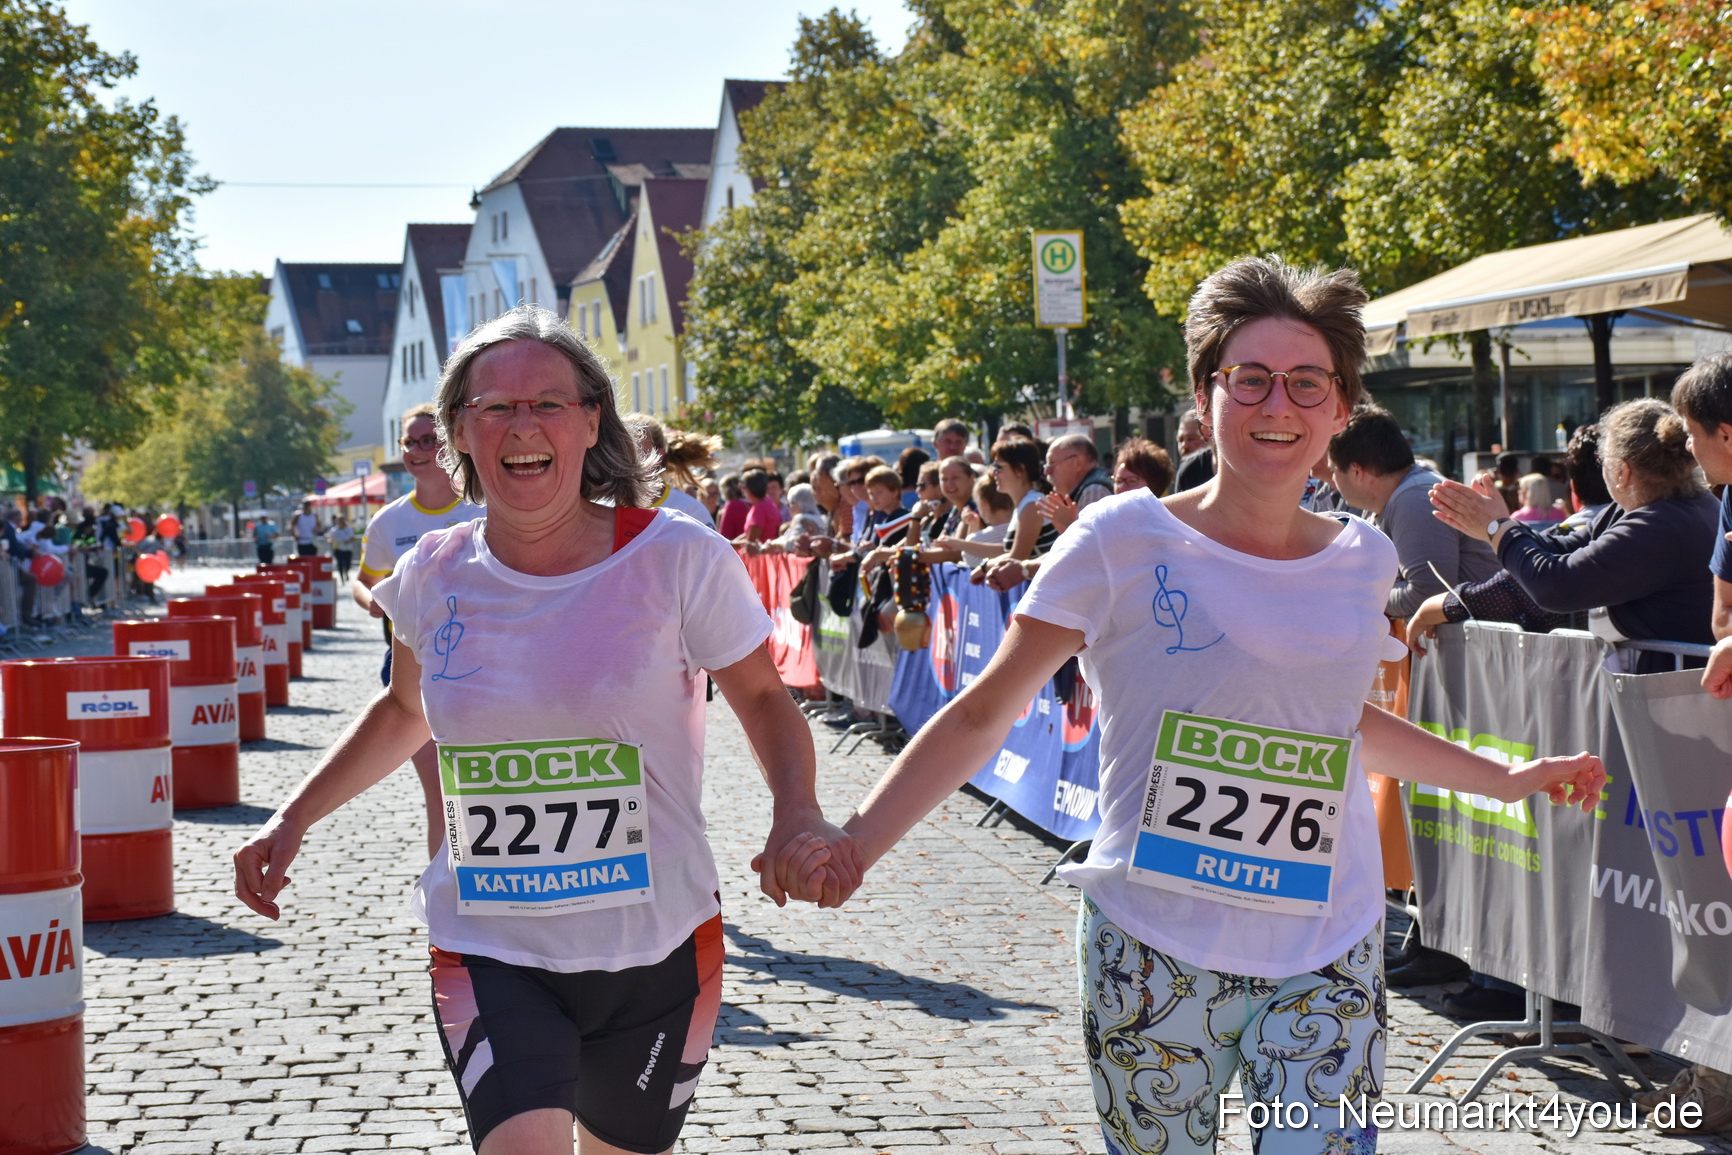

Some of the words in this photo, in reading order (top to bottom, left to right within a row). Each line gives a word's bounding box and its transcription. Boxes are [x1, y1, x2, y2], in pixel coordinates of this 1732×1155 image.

[191, 698, 236, 726] AVIA
[454, 744, 627, 789] BOCK
[1171, 719, 1339, 784] BOCK
[628, 800, 637, 811] D
[1166, 776, 1325, 852] 2276
[1328, 805, 1336, 816] D
[467, 798, 620, 856] 2277
[473, 863, 630, 893] KATHARINA
[1195, 853, 1281, 890] RUTH
